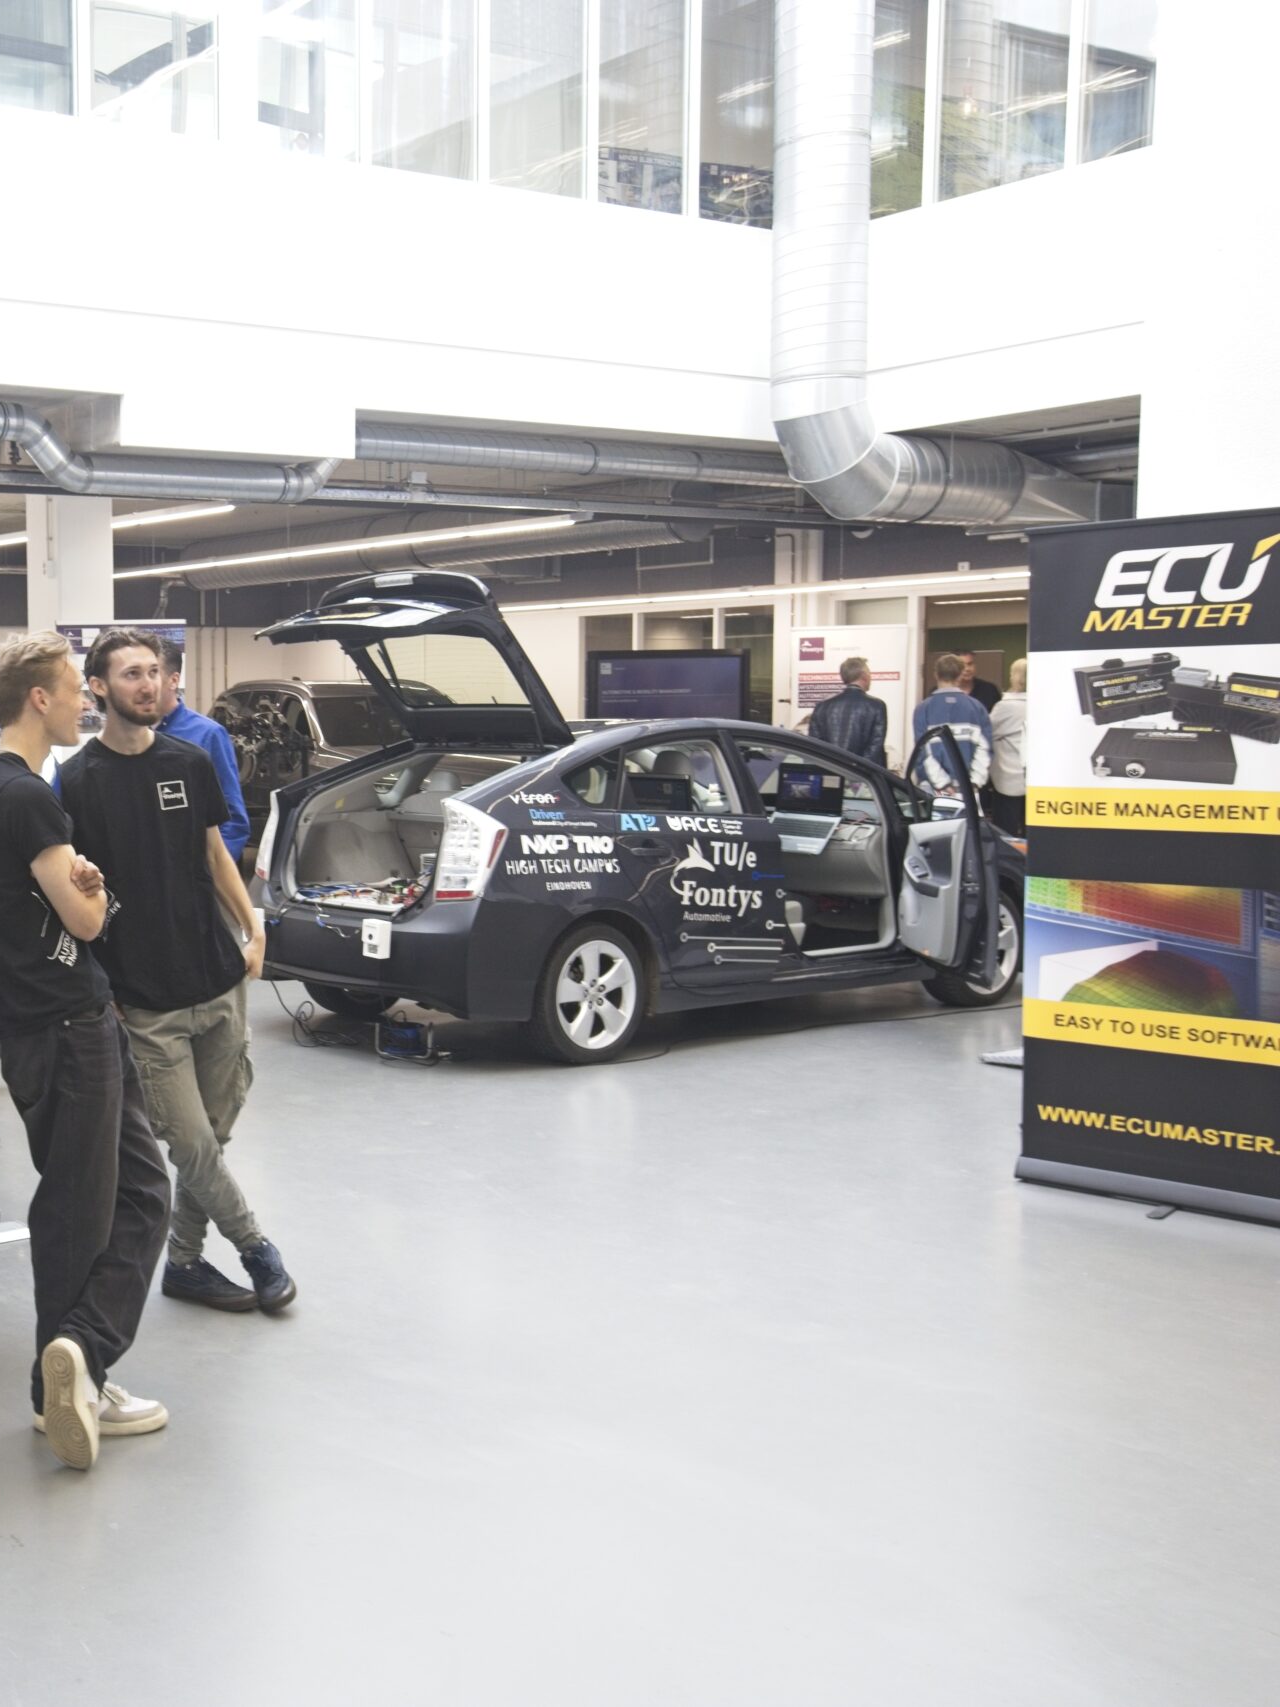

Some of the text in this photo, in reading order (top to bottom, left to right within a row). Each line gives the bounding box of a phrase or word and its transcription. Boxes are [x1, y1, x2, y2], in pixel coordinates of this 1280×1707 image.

[1095, 543, 1271, 608] ECU
[1082, 603, 1253, 632] MASTER
[529, 808, 564, 820] Driven
[1036, 801, 1107, 816] ENGINE
[1114, 802, 1269, 821] MANAGEMENT
[520, 835, 568, 854] NXP
[573, 835, 614, 854] TNO
[709, 841, 757, 871] TU/e
[505, 858, 620, 875] HIGH TECH CAMPUS
[680, 880, 763, 917] Fontys
[683, 911, 732, 922] Automotive
[1053, 1014, 1103, 1030] EASY
[1110, 1020, 1135, 1034] TO
[1141, 1024, 1181, 1040] USE
